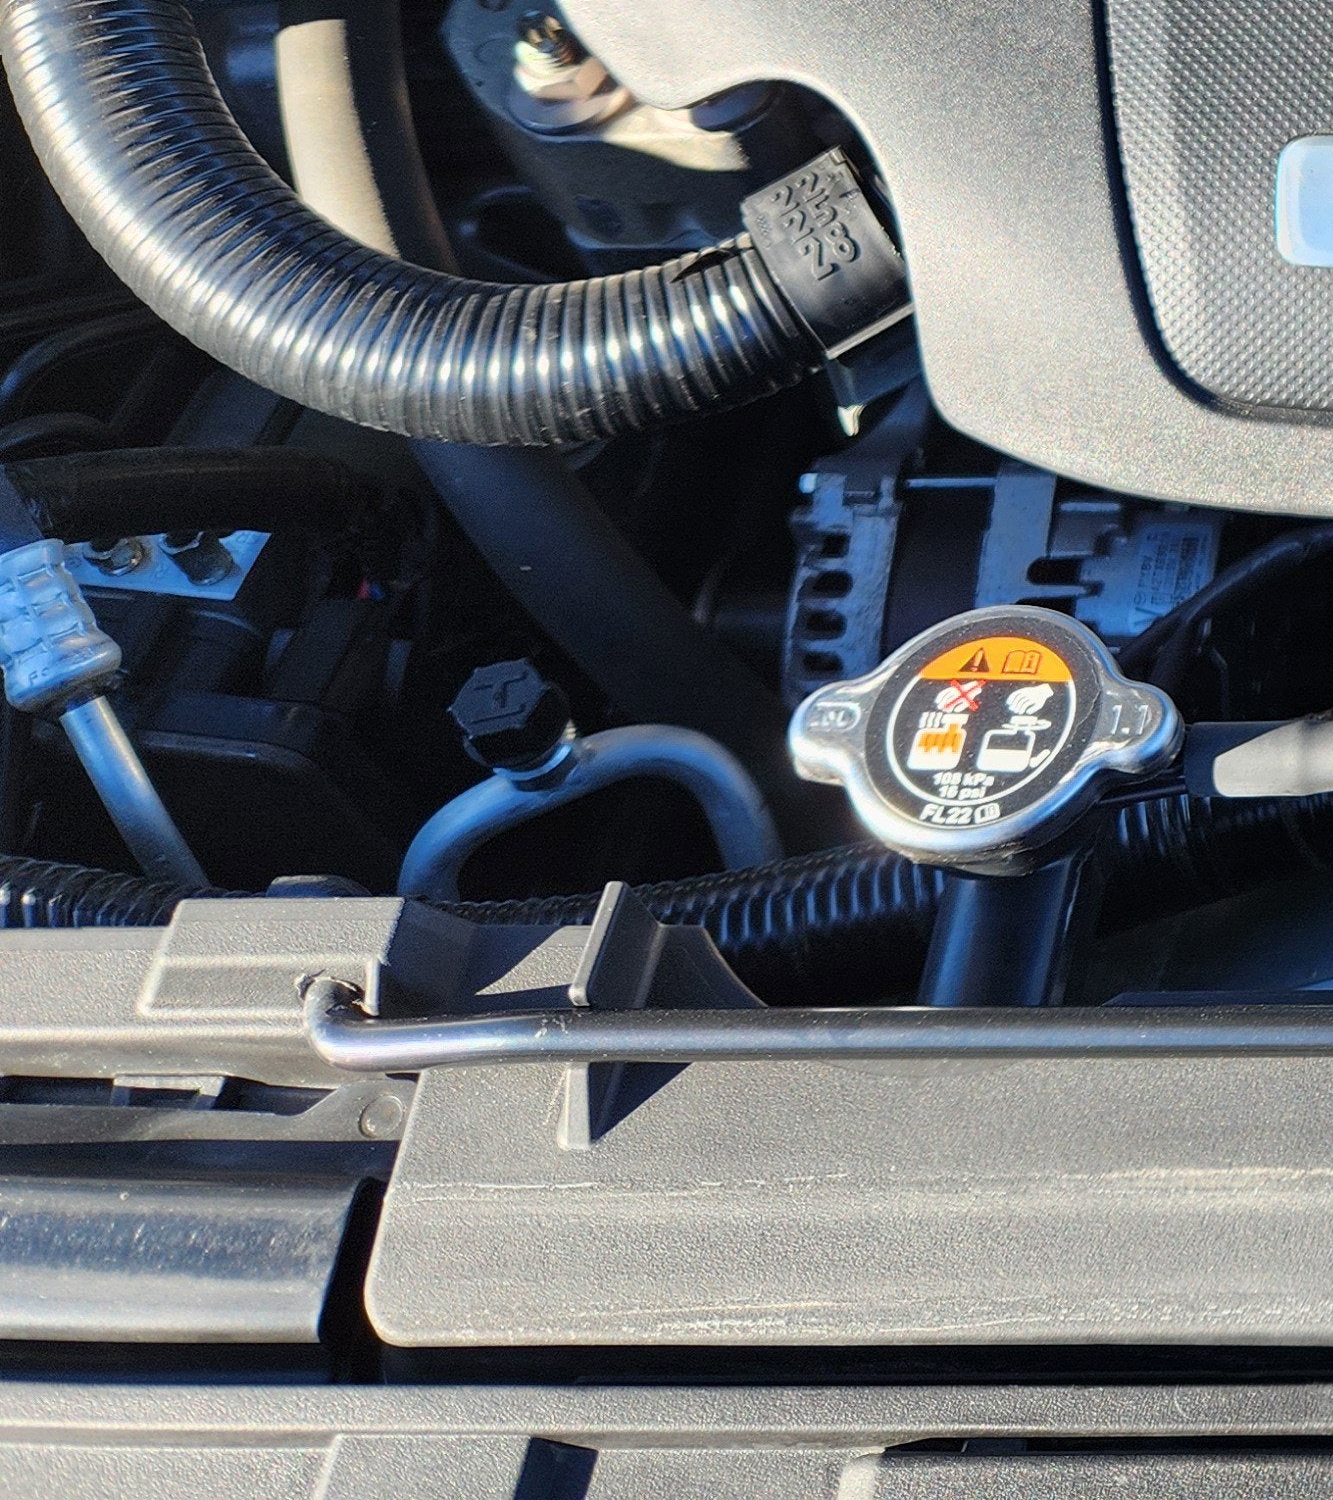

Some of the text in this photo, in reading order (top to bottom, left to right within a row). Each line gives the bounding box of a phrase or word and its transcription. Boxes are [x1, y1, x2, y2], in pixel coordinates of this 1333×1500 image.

[800, 221, 861, 281] 28
[958, 786, 987, 801] psi
[919, 803, 973, 825] FL22
